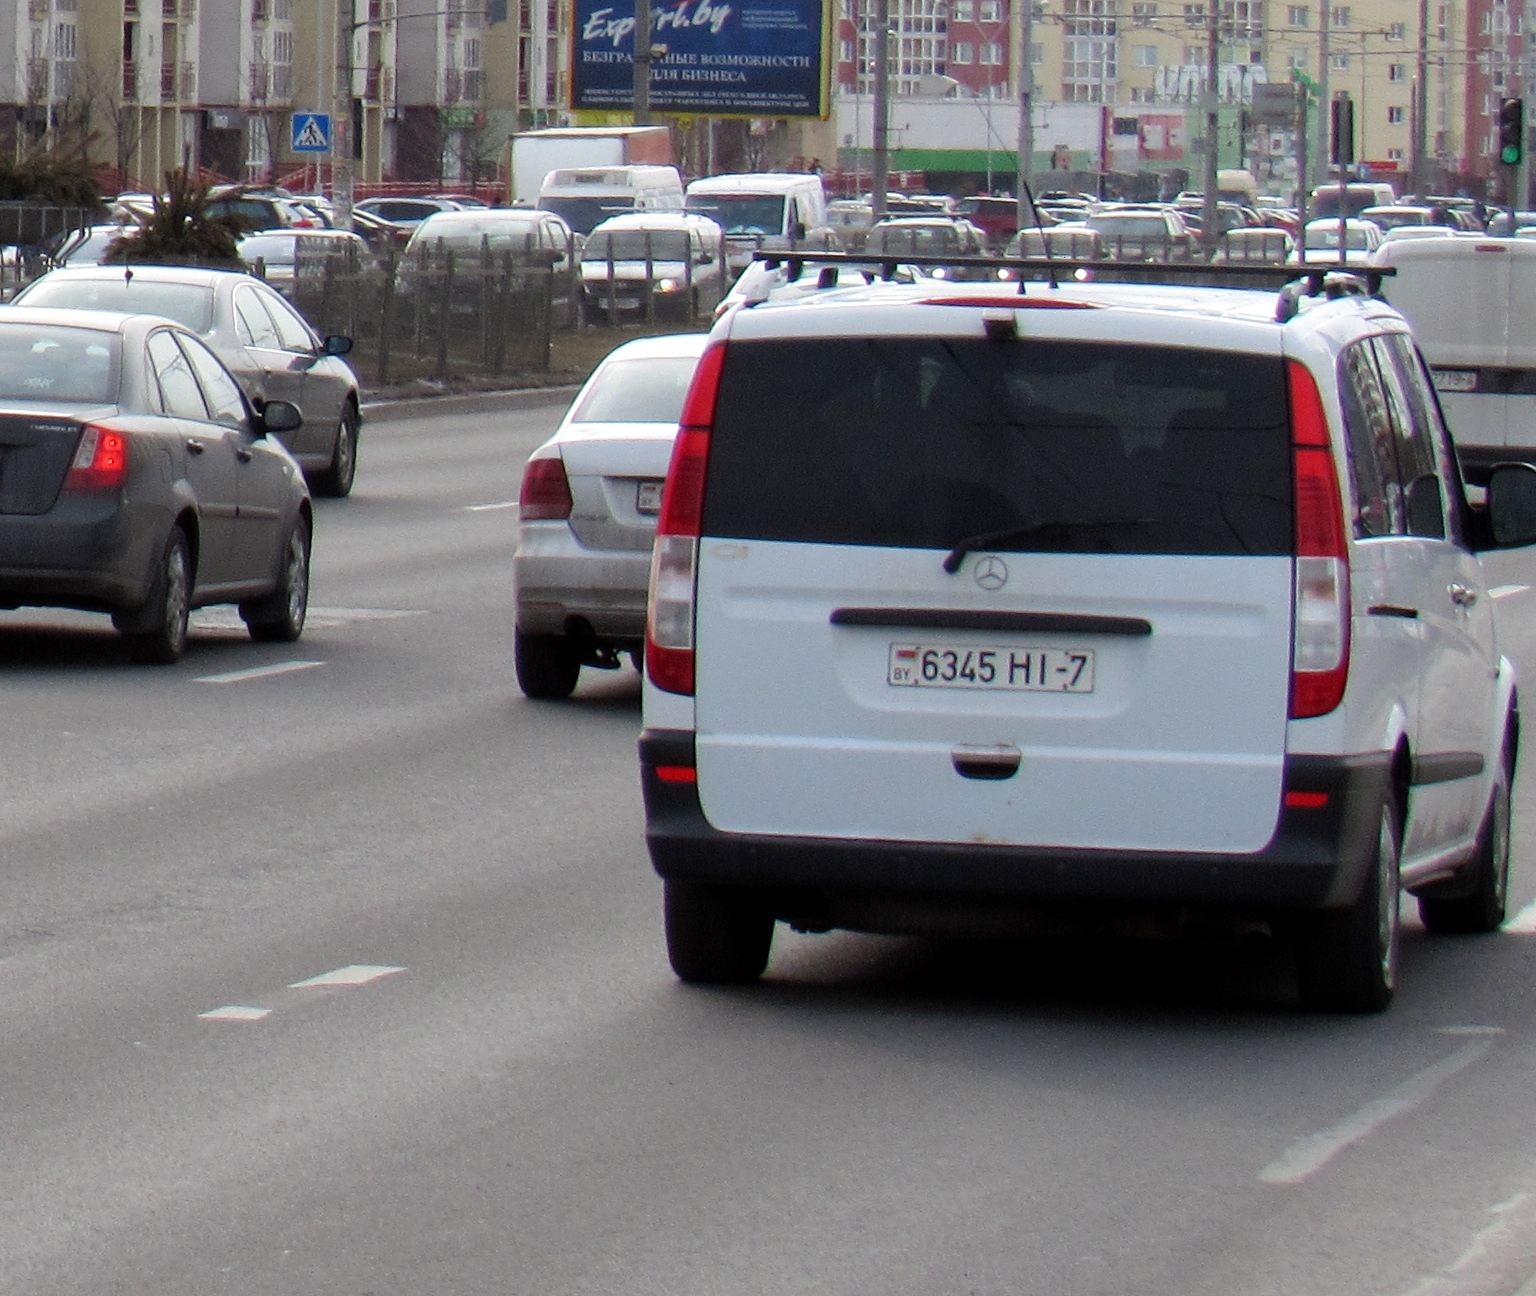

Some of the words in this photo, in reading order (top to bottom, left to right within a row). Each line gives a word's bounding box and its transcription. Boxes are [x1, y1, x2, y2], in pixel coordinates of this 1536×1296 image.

[583, 50, 697, 64] БЕЗГРАНЫЕ
[701, 53, 810, 68] ВОЗМОЖНОСТИ
[681, 69, 747, 82] БИЗНЕСА
[894, 667, 911, 681] BY
[922, 650, 997, 683] 6345
[1008, 652, 1088, 686] HI-7
